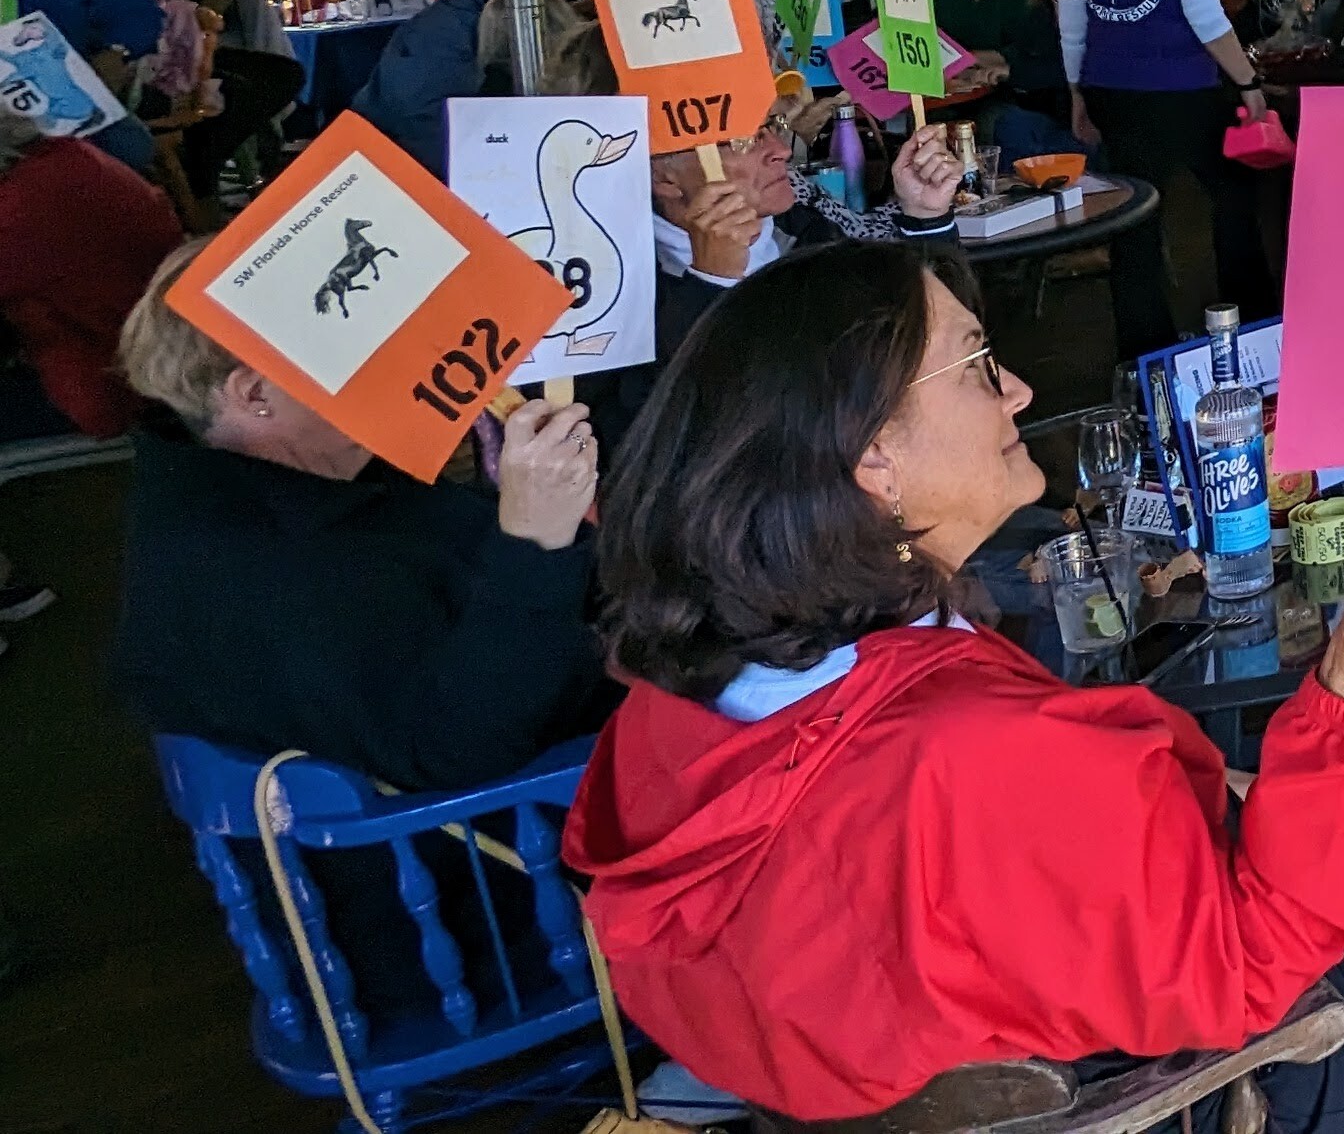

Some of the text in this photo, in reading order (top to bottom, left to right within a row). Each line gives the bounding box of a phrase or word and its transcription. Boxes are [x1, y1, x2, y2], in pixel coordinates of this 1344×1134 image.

[896, 30, 931, 69] 150
[661, 93, 732, 137] 107
[233, 173, 359, 287] SW Florida Horse Rescue
[534, 256, 592, 309] 8
[412, 317, 521, 423] 102
